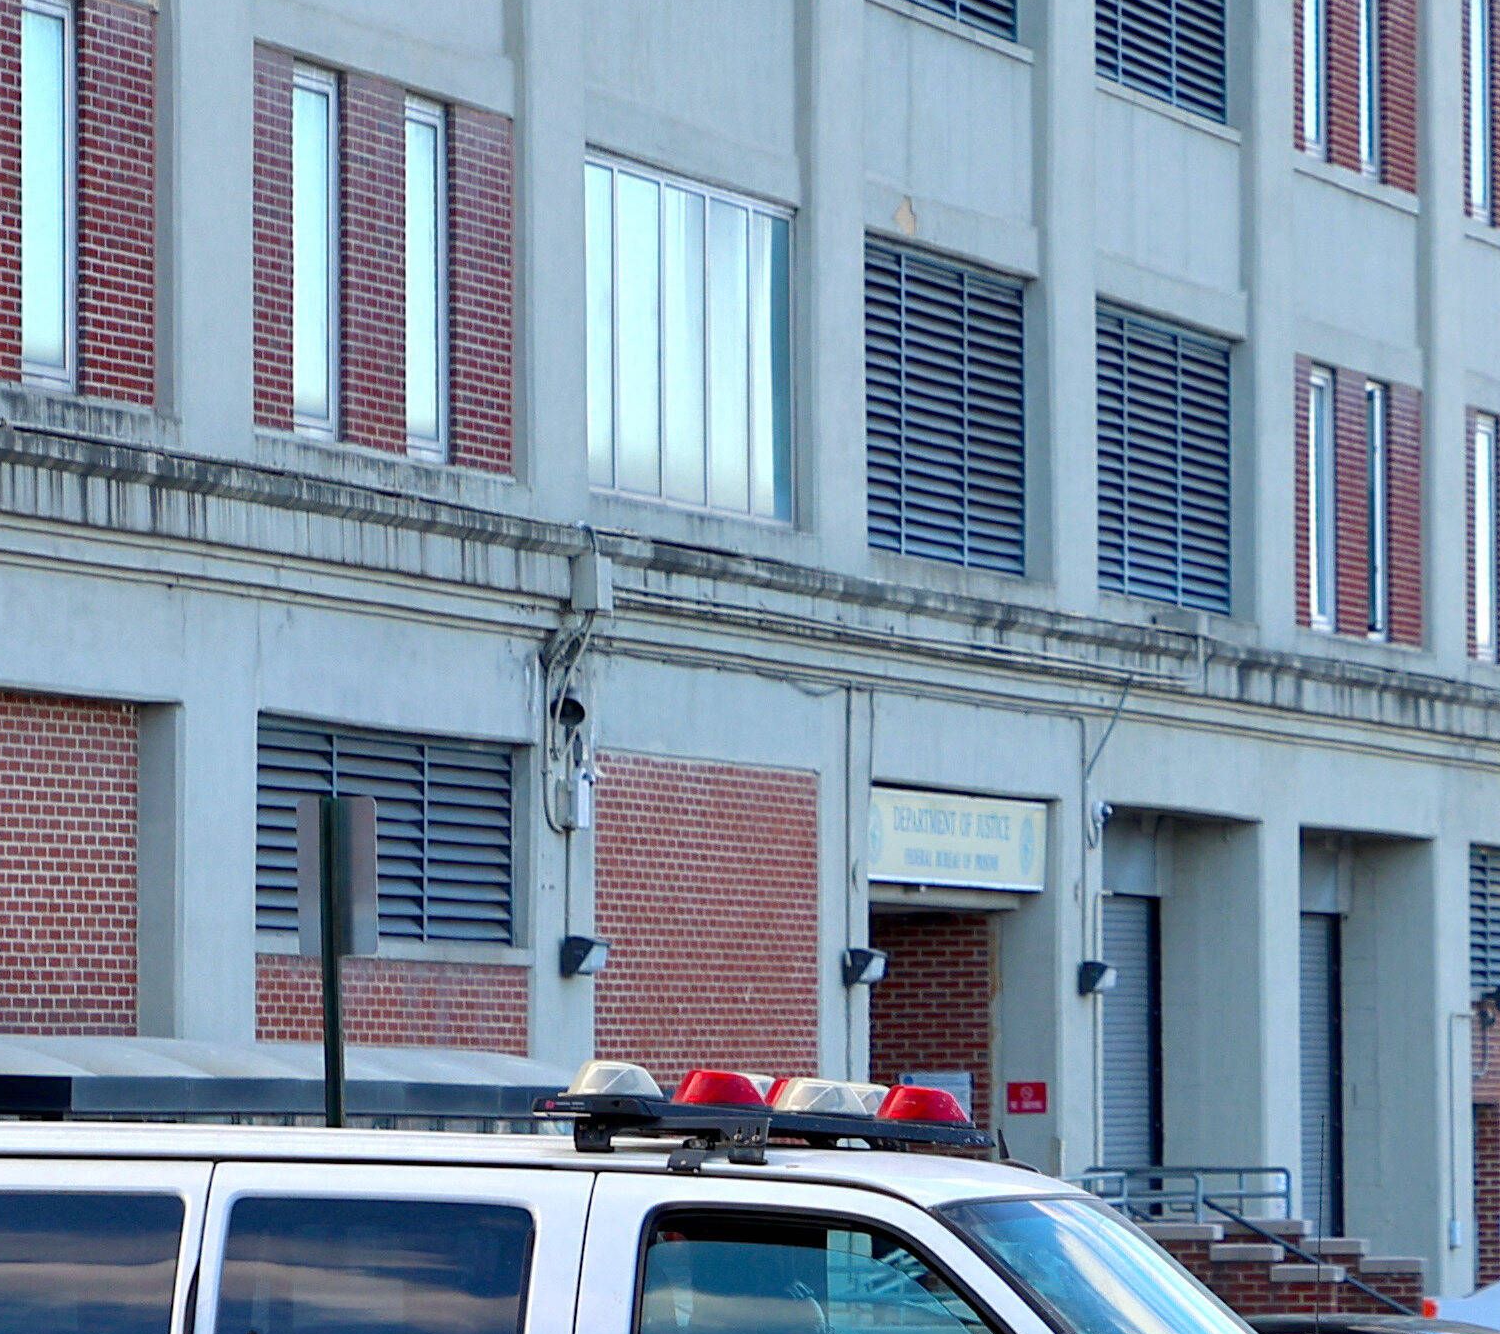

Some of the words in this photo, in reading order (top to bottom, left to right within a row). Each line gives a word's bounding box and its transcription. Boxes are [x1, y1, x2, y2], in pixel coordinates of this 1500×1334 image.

[893, 806, 955, 836] DEPARTMENT
[960, 812, 972, 837] OF
[976, 814, 1011, 841] JUSTICE
